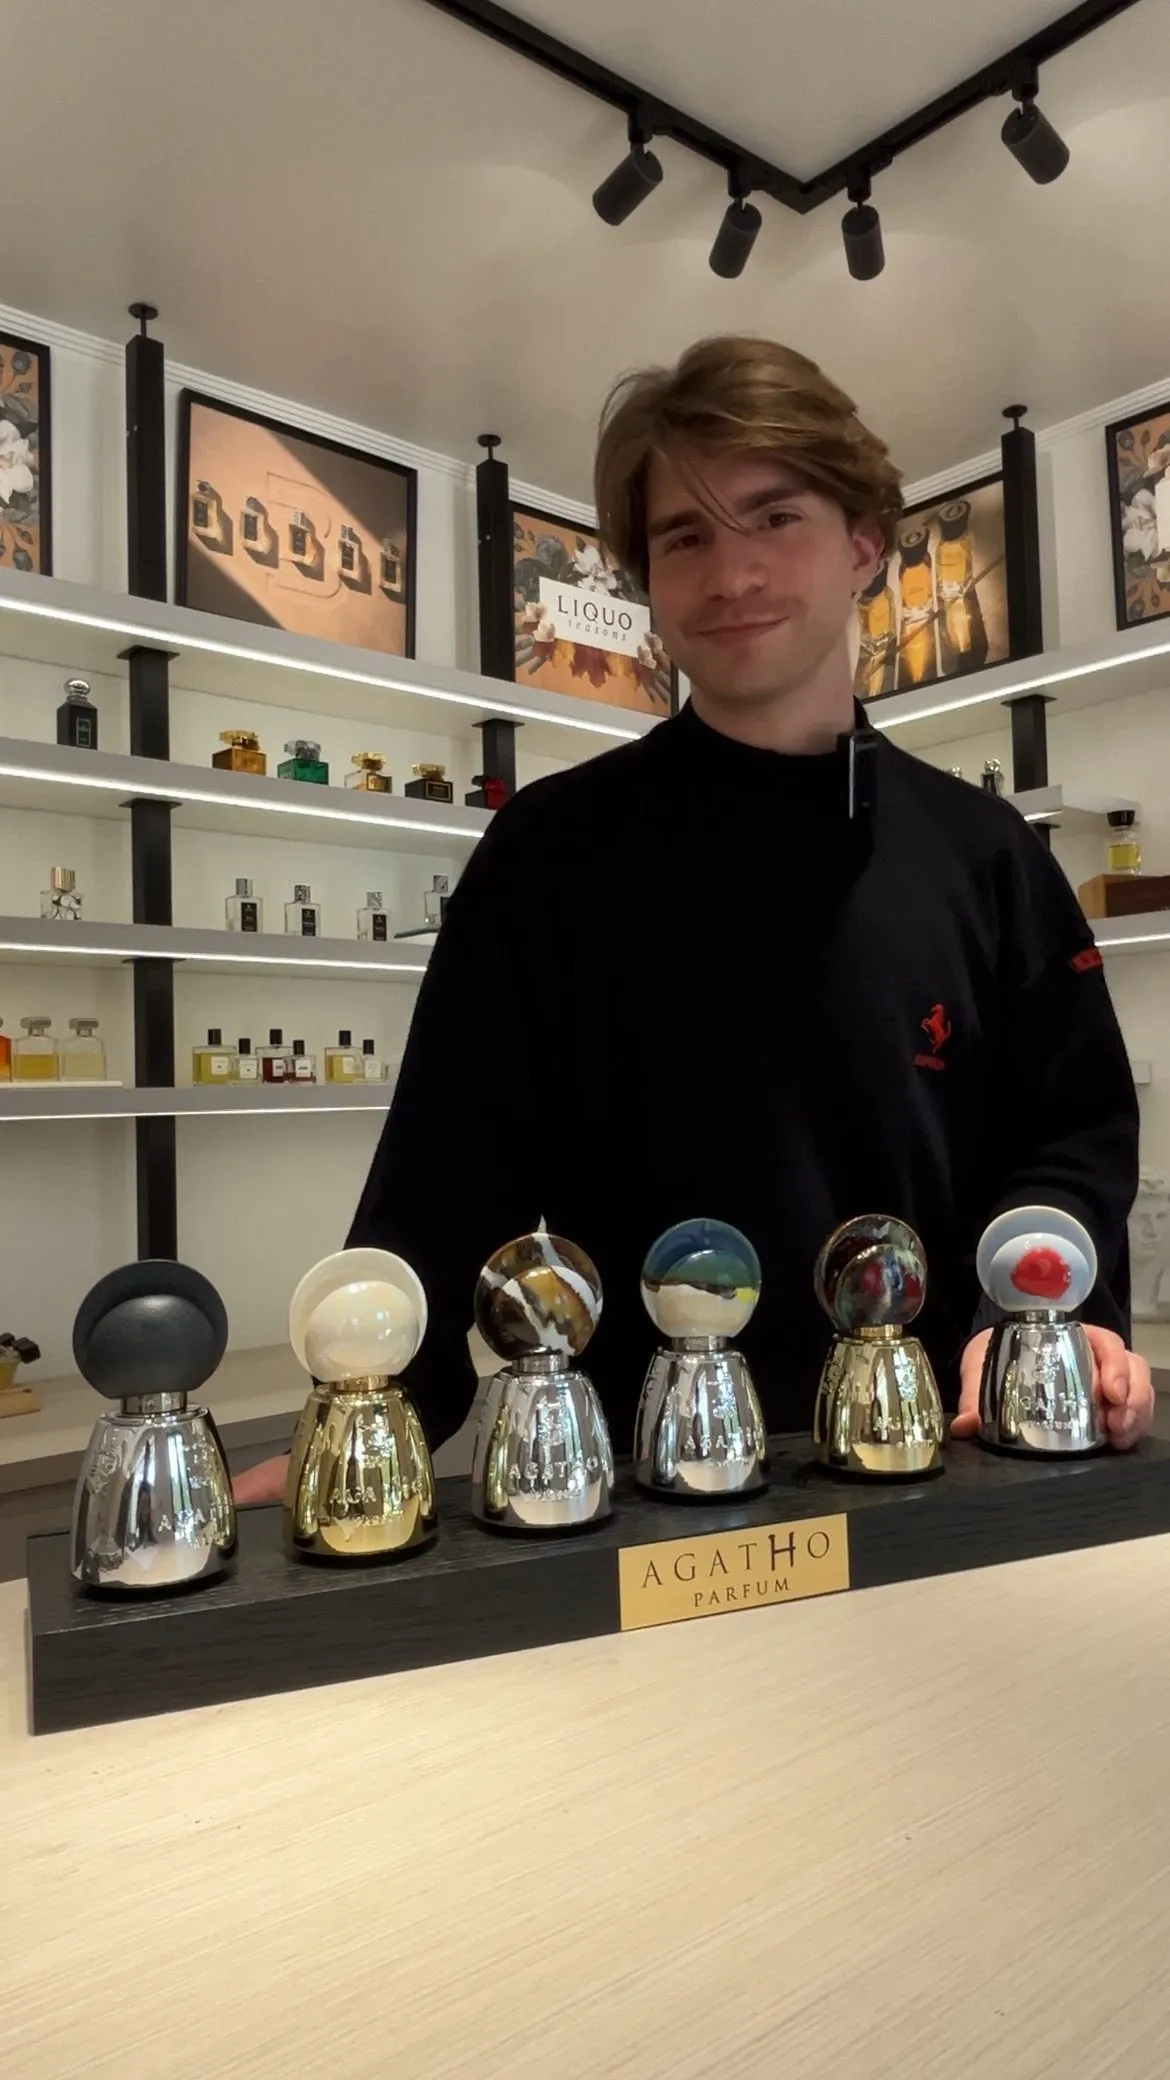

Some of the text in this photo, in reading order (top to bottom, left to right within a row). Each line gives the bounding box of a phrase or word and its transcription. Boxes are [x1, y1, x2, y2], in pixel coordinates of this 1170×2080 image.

[557, 594, 632, 631] LIQUO
[641, 1531, 830, 1589] AGATHO
[693, 1577, 790, 1608] PARFUM
